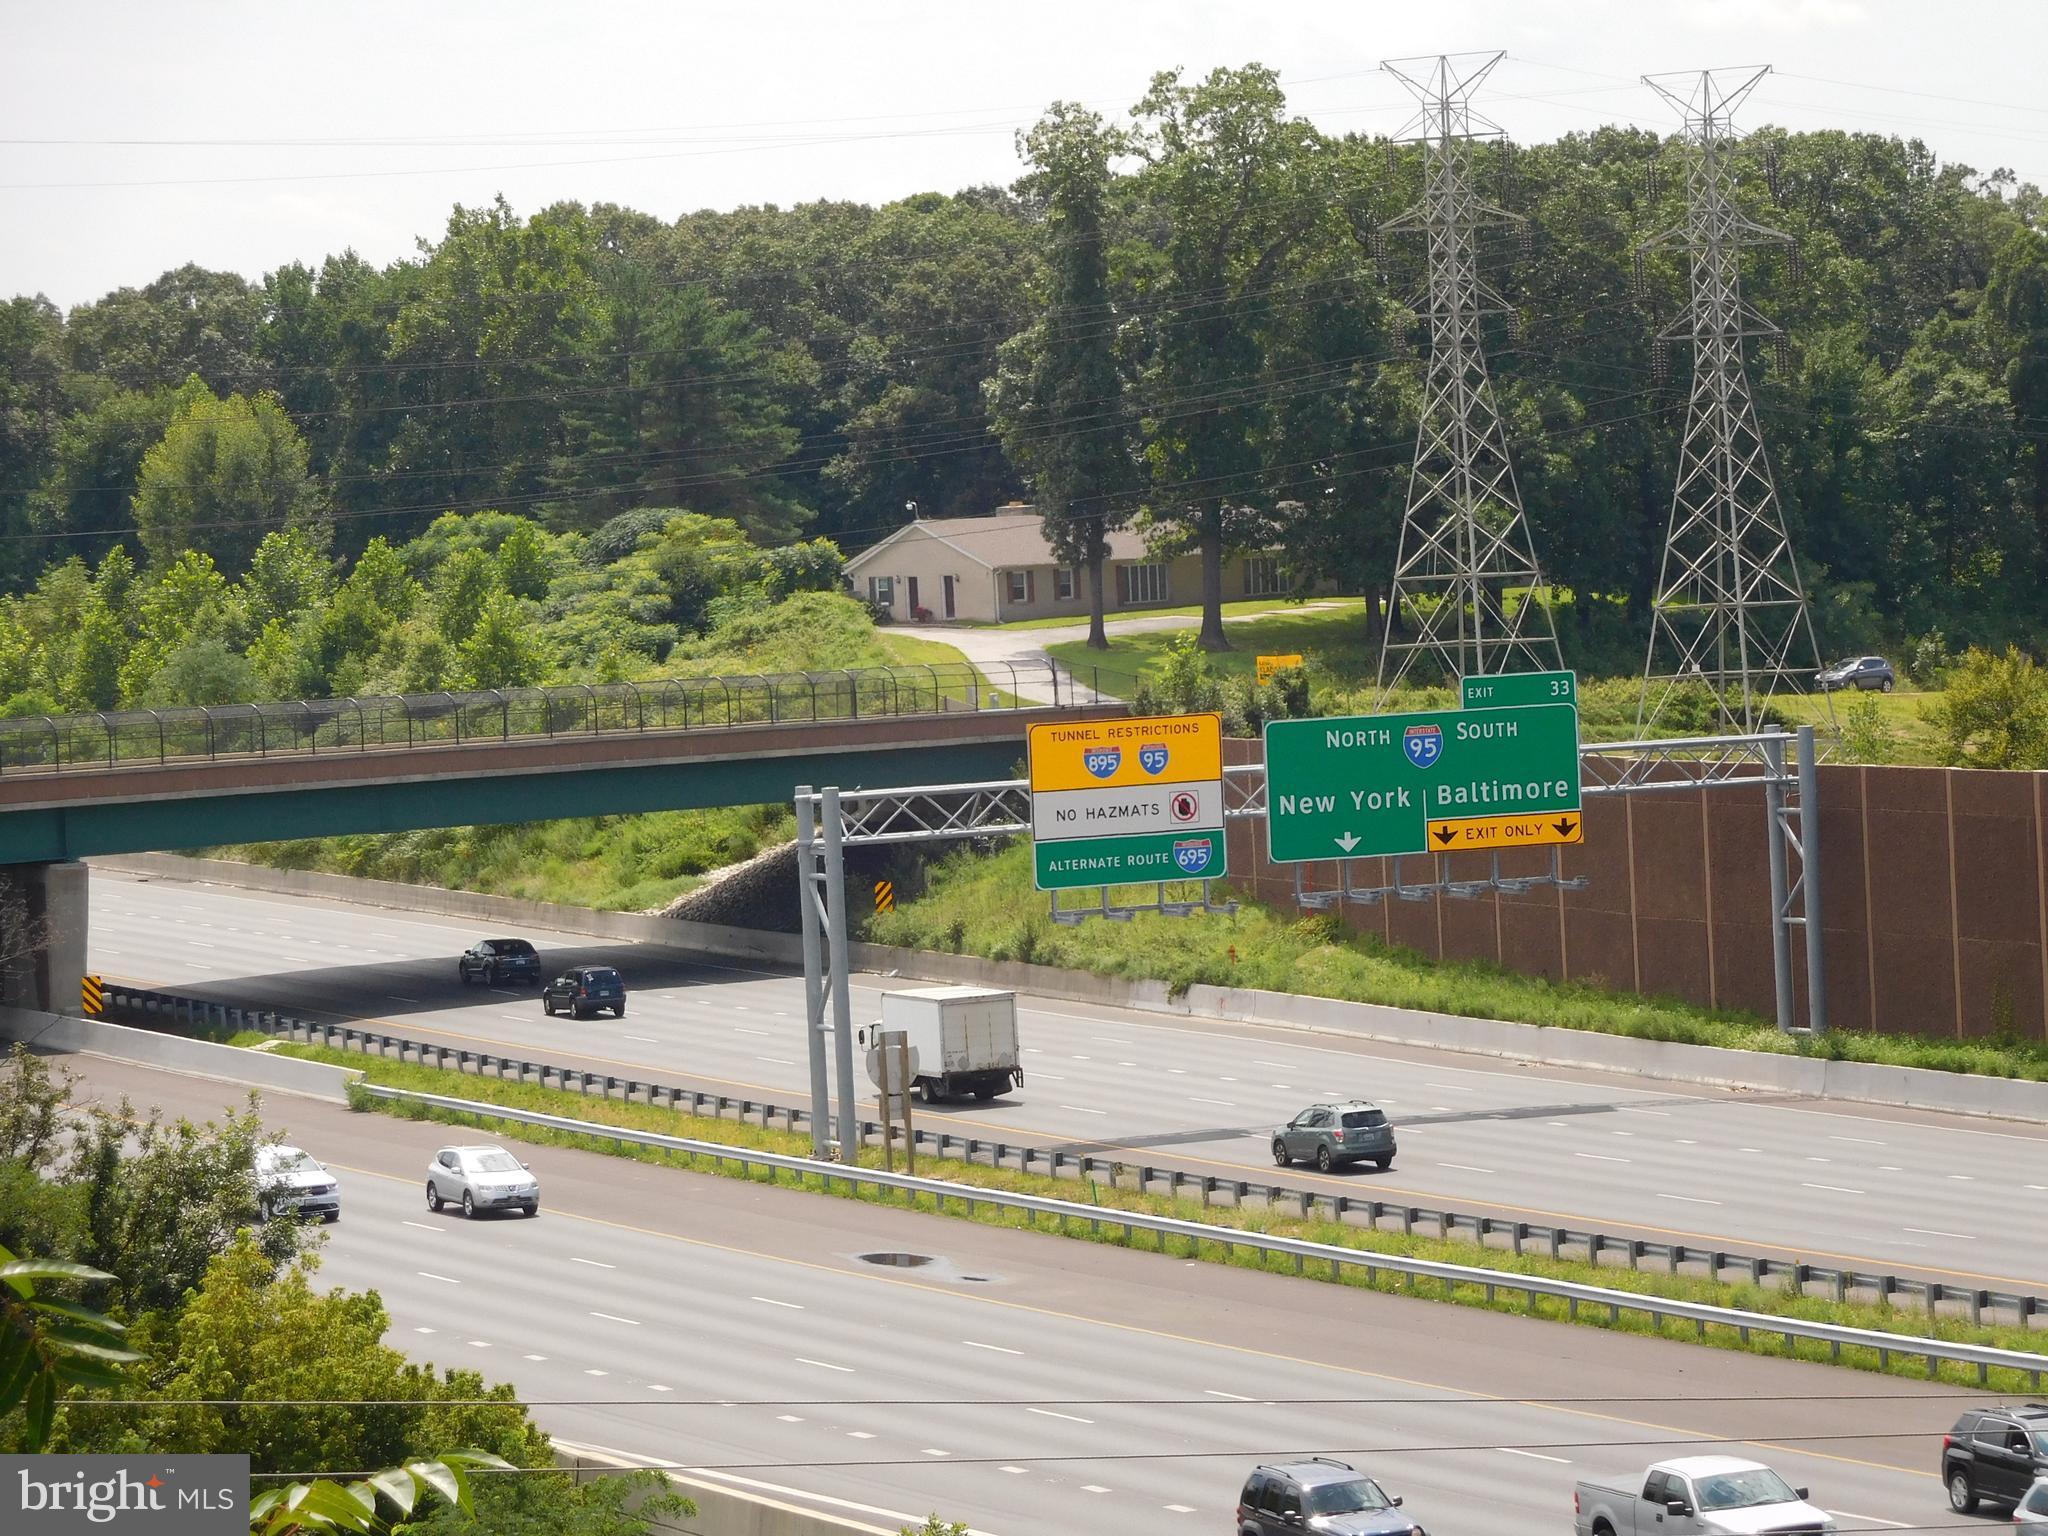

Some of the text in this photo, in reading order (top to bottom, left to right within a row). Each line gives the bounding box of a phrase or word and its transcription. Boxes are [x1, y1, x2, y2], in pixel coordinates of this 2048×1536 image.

[1467, 680, 1570, 699] EXIT 33
[1051, 722, 1200, 742] TUNNEL RESTRICTIONS
[1326, 729, 1391, 749] NORTH
[1456, 721, 1518, 741] SOUTH
[1410, 737, 1437, 758] 95
[1088, 751, 1165, 772] 895 95
[1279, 786, 1411, 816] New York
[1437, 779, 1569, 806] Baltimore
[1056, 803, 1160, 822] NO HAZMATS
[1466, 823, 1544, 840] EXIT ONLY
[1049, 848, 1208, 871] ALTERNATE ROUTE 695
